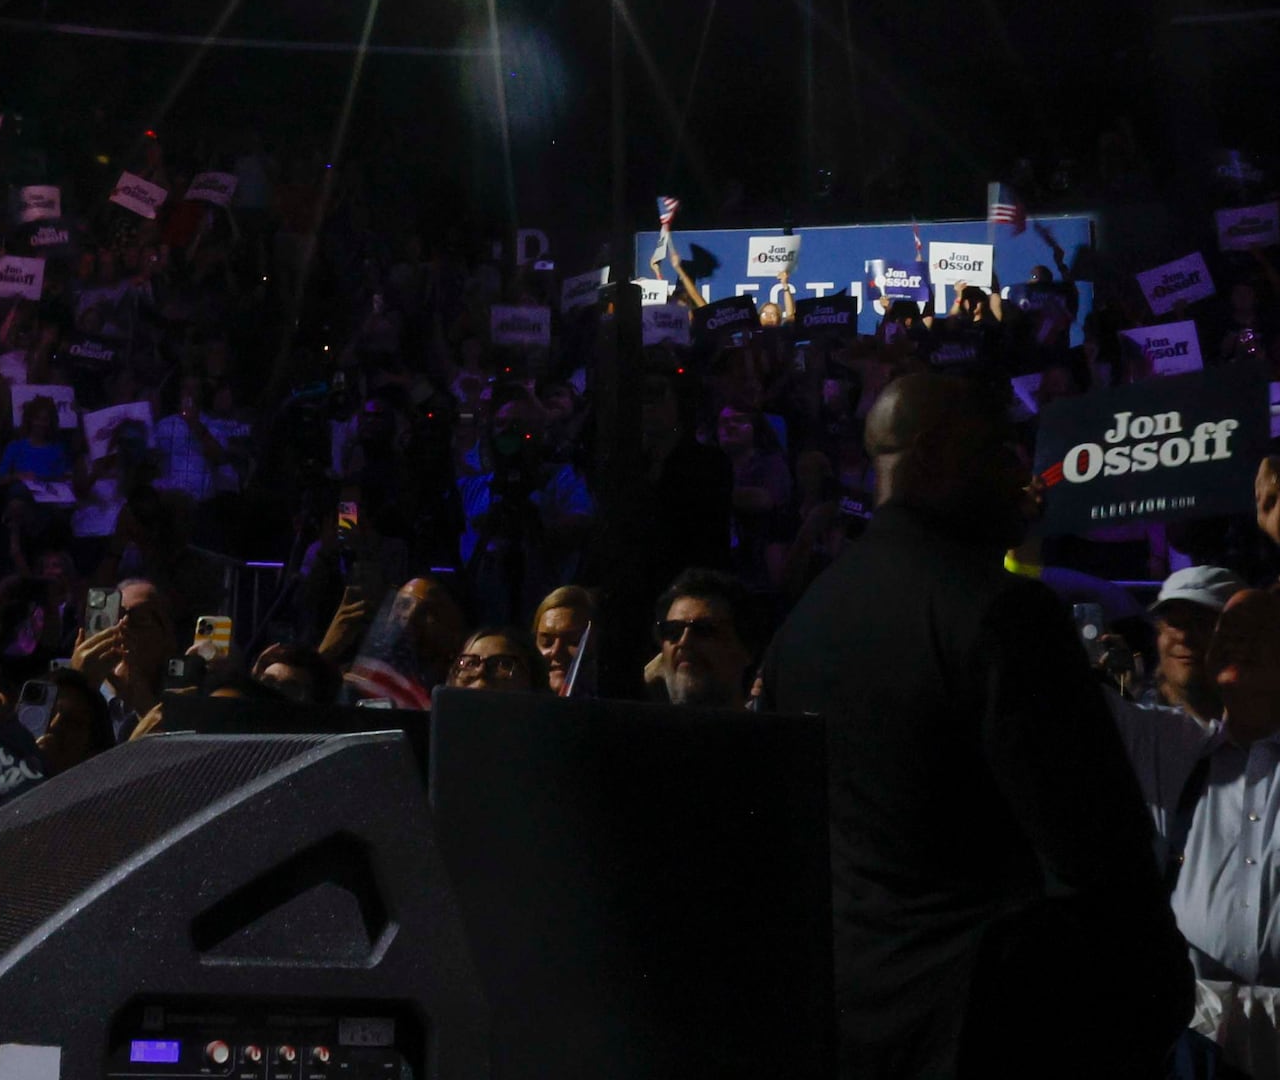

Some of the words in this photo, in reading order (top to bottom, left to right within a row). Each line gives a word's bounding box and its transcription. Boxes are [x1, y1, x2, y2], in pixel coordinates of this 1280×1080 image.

[768, 245, 786, 254] Jon
[948, 252, 970, 262] Jon
[938, 258, 985, 272] Ossoff
[884, 268, 908, 279] Jon
[1104, 410, 1183, 444] Jon
[1062, 418, 1240, 484] Ossoff
